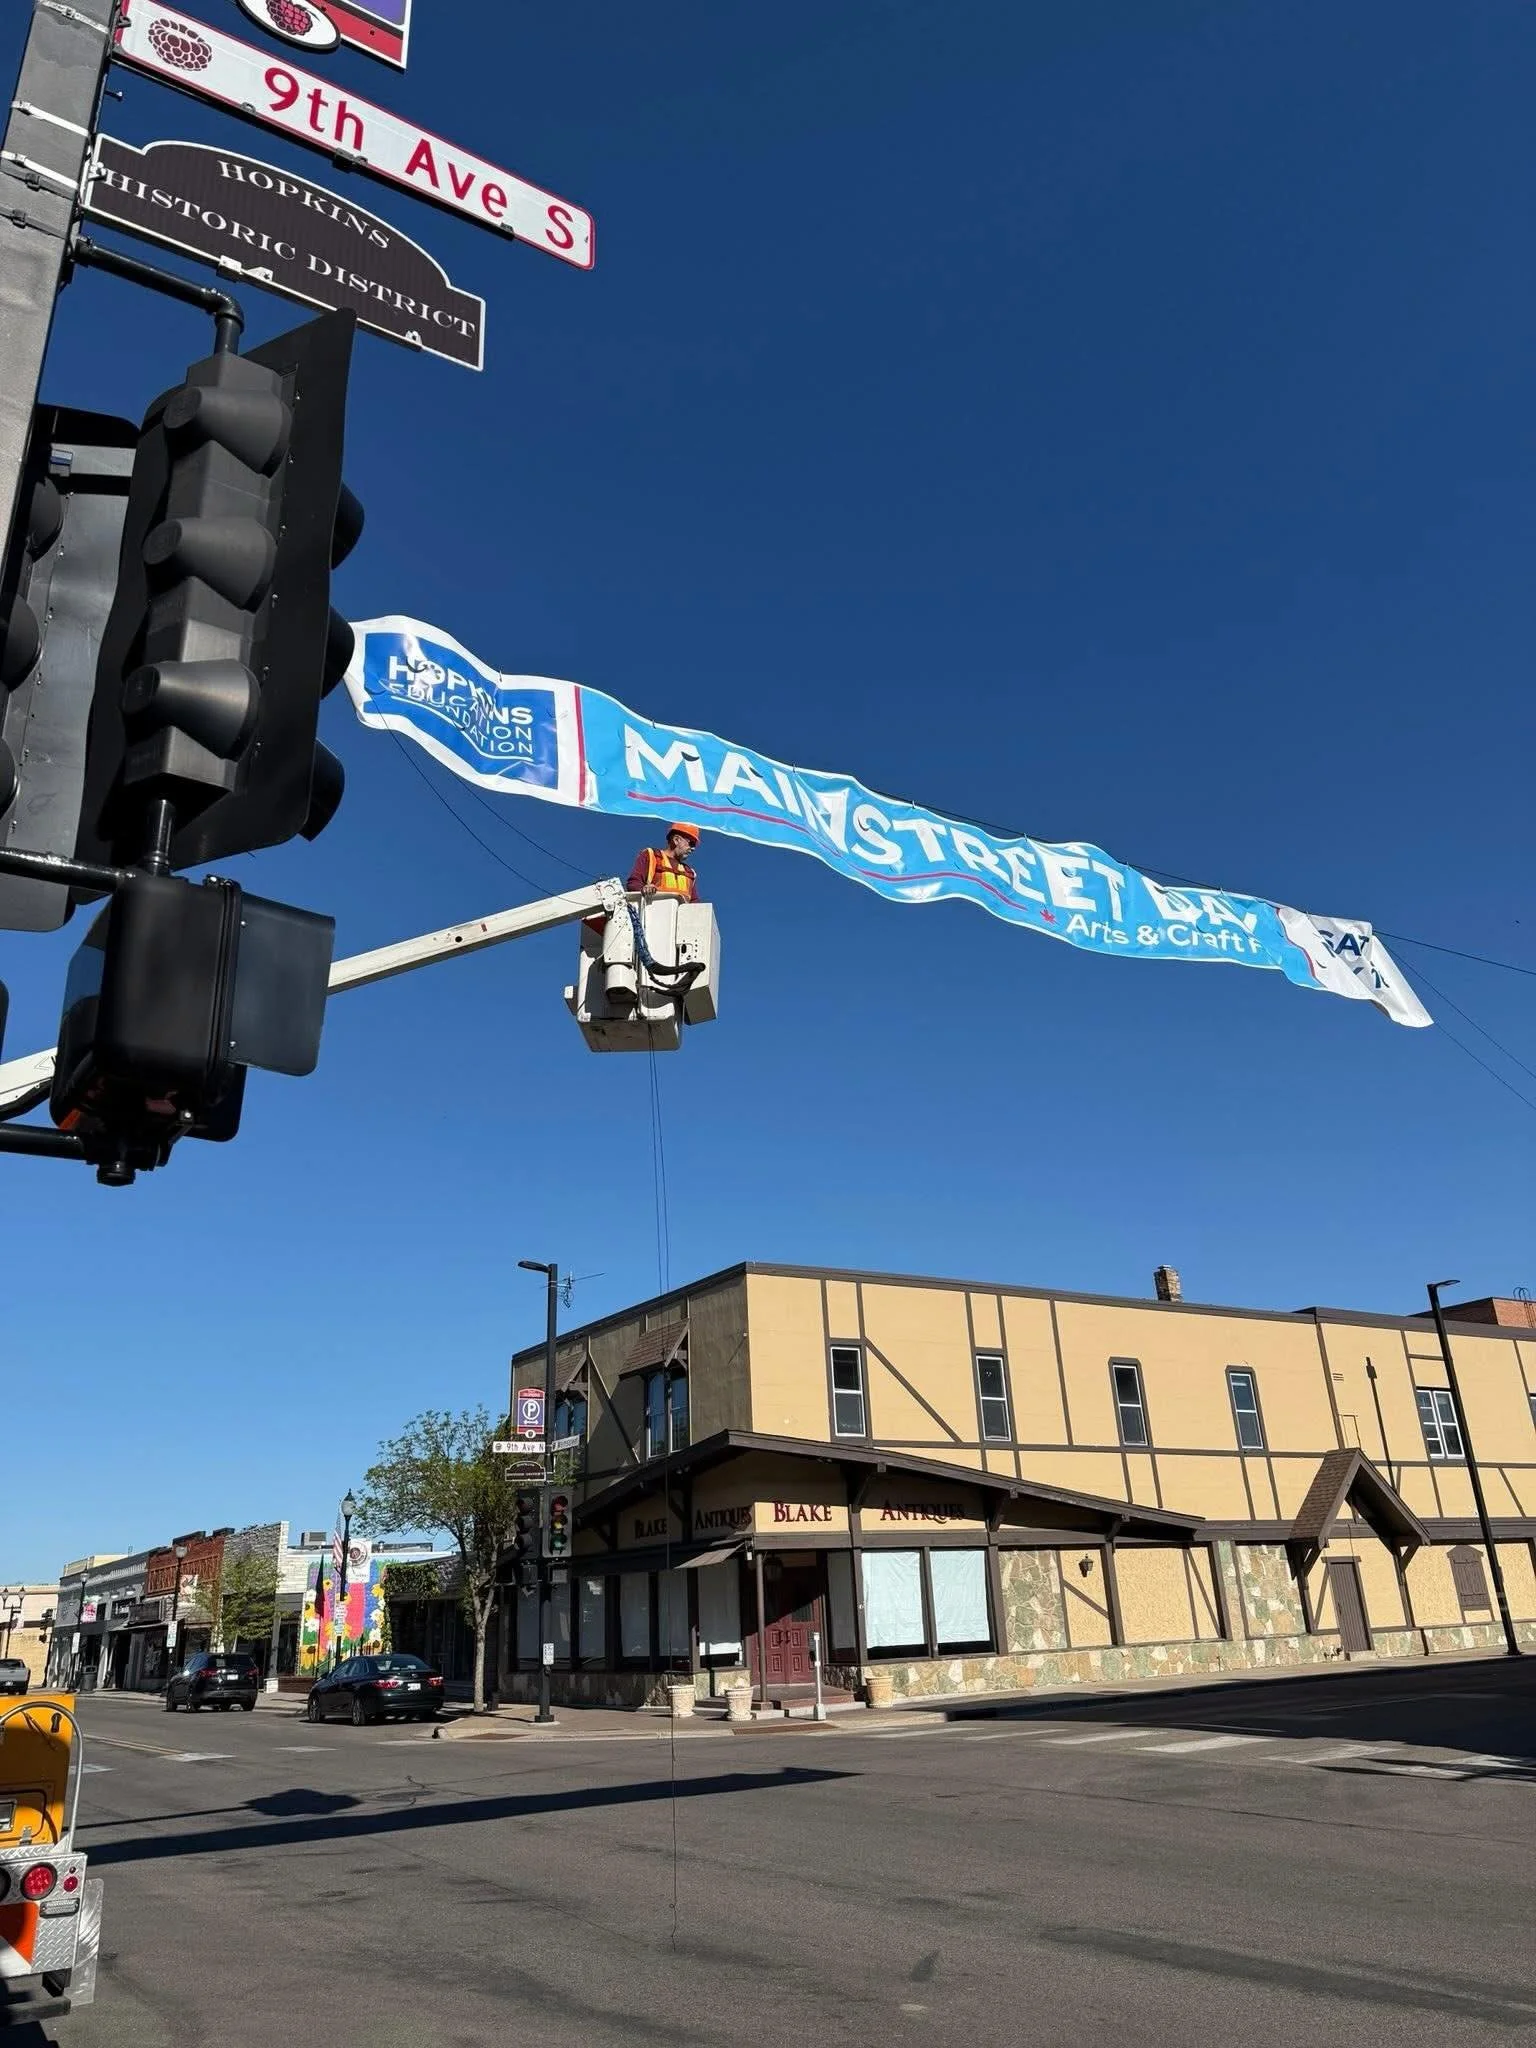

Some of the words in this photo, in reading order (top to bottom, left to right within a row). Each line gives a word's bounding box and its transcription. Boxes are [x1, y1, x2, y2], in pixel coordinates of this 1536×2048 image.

[263, 66, 364, 151] 9th
[404, 138, 509, 219] Ave
[544, 204, 575, 250] S
[218, 160, 390, 250] HOPKINS
[104, 167, 297, 260] HISTORIC
[306, 253, 476, 338] DISTRICT
[388, 655, 534, 726] HOPKINS
[388, 682, 533, 741] EDUCATION
[624, 723, 1126, 922] MAINSTREET
[1066, 913, 1129, 944] Arts
[1136, 925, 1160, 947] &
[506, 1443, 519, 1452] 9th
[522, 1443, 535, 1452] Ave
[539, 1443, 545, 1452] N
[634, 1517, 668, 1539] BLAKE
[773, 1500, 832, 1522] BLAKE
[880, 1499, 967, 1525] ANTIQUES
